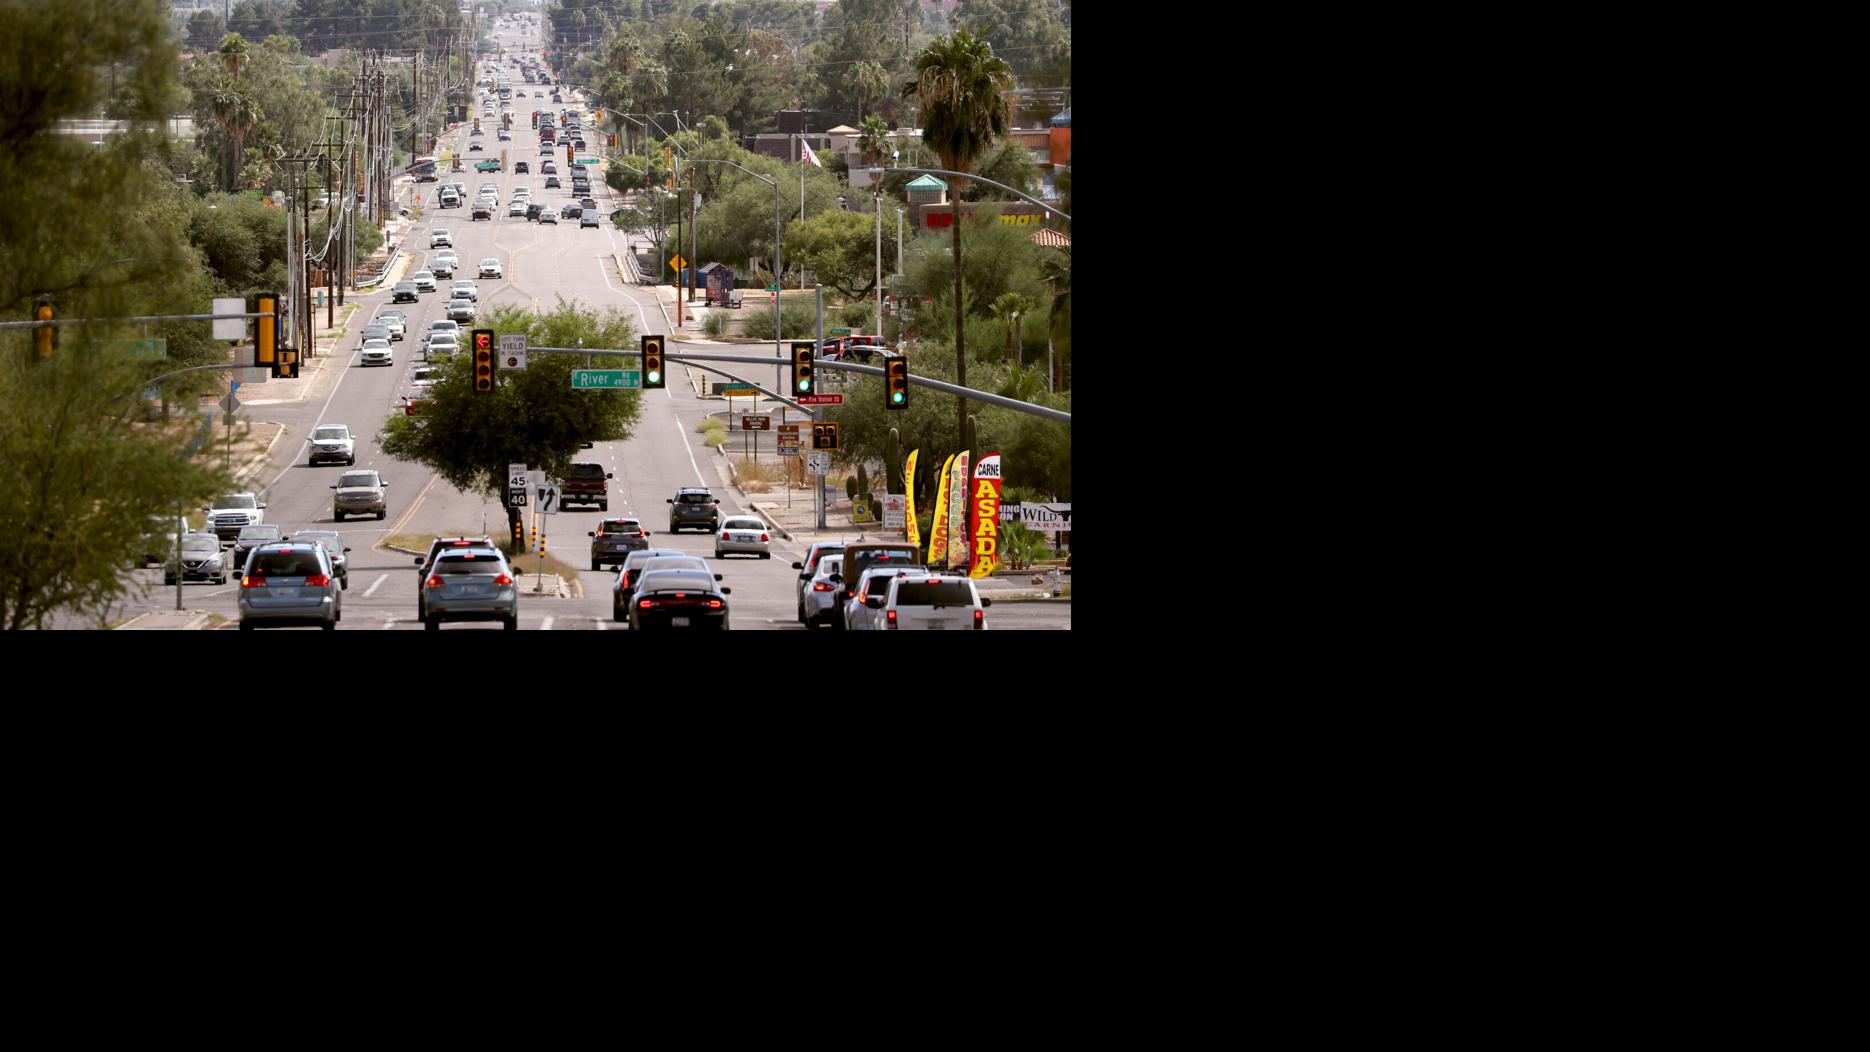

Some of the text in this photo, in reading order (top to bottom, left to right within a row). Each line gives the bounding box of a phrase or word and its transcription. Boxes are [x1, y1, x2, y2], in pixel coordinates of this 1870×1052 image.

[502, 342, 524, 350] YIELD
[581, 372, 609, 386] River
[978, 463, 999, 477] CARNE
[511, 476, 526, 486] 45
[511, 495, 526, 505] 40
[1022, 508, 1058, 522] WILD
[975, 480, 999, 573] ASADA
